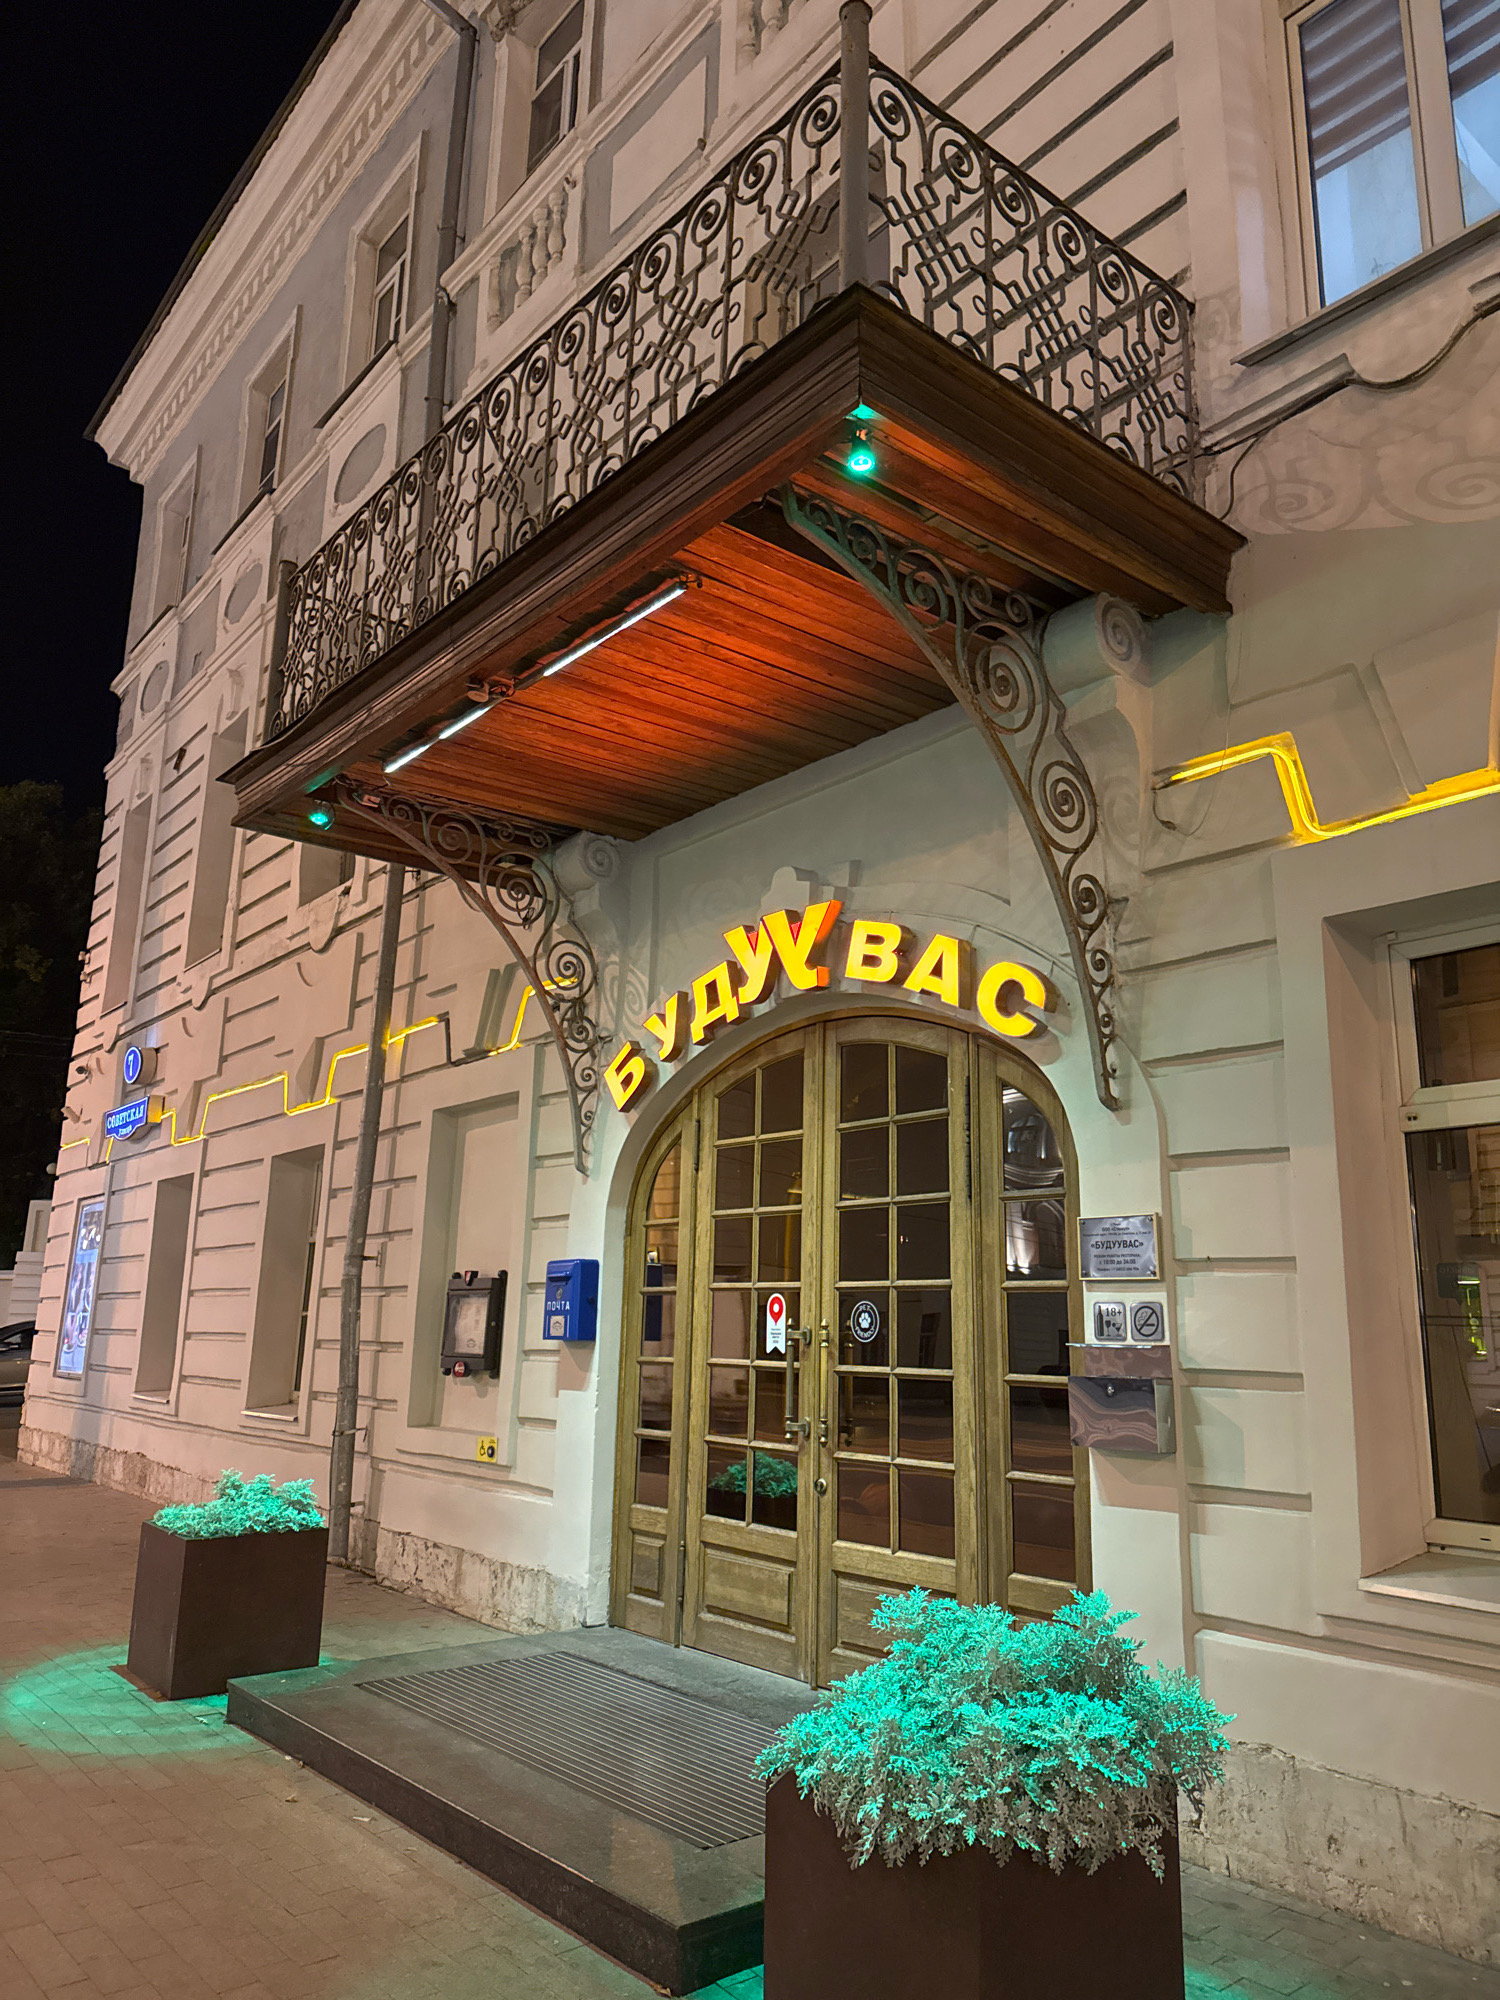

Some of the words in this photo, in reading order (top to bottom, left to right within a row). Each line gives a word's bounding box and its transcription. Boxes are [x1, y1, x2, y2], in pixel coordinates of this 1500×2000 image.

[128, 1053, 134, 1077] 7
[107, 1104, 145, 1129] СОВЕТСКАЯ
[1090, 1239, 1144, 1250] «БУДУУВАС»
[546, 1301, 570, 1311] ПОЧТА
[1105, 1307, 1122, 1317] 18+
[855, 1325, 874, 1338] FRIENDLY
